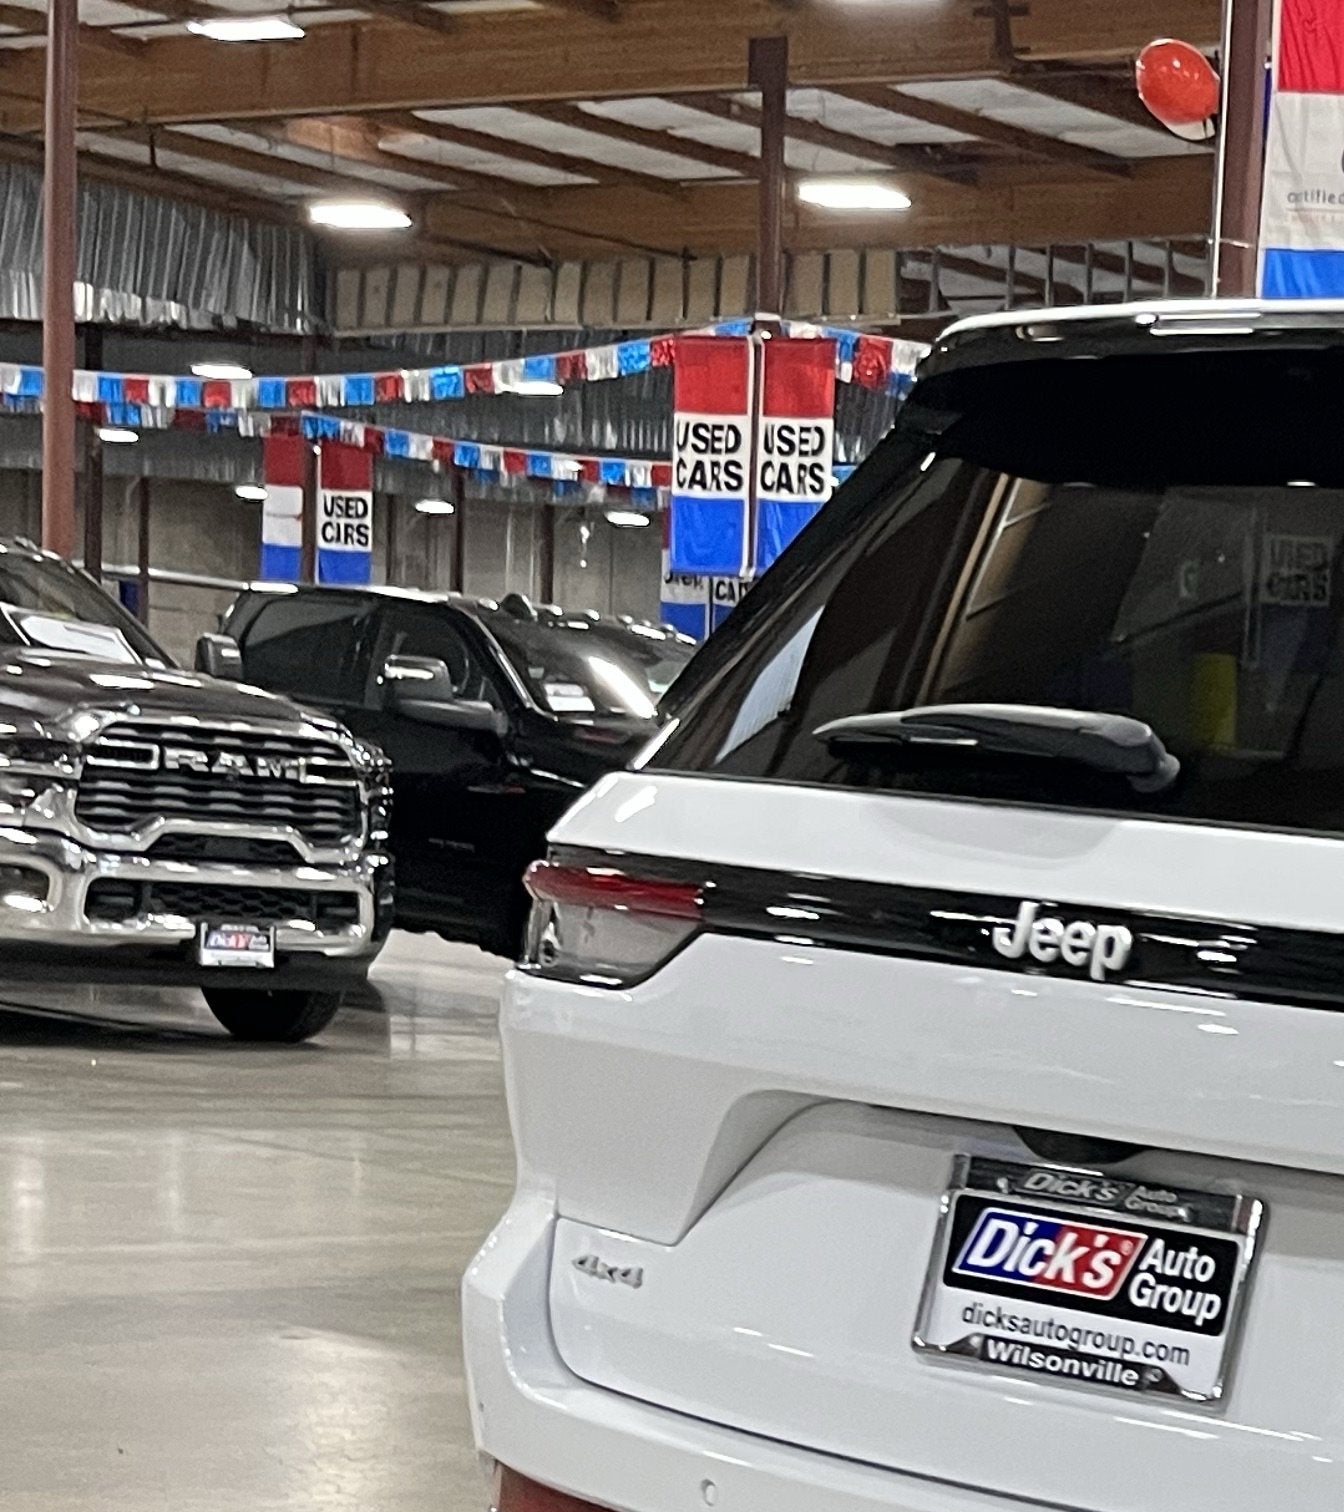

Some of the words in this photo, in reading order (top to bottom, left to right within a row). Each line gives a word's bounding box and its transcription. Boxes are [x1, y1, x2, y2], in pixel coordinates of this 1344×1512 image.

[676, 421, 741, 455] USED
[764, 425, 825, 457] USED
[675, 458, 744, 491] CARS
[760, 460, 825, 495] CARS
[323, 495, 368, 519] USED
[165, 747, 299, 779] RAM
[993, 901, 1132, 981] Jeep
[1024, 1173, 1119, 1201] Dick's
[966, 1218, 1122, 1289] Dick's
[1138, 1238, 1216, 1283] Auto
[572, 1254, 643, 1289] 4x4
[1128, 1272, 1222, 1326] Group
[961, 1302, 1191, 1366] dicksautogroup.com
[986, 1337, 1140, 1387] Wilsonville
